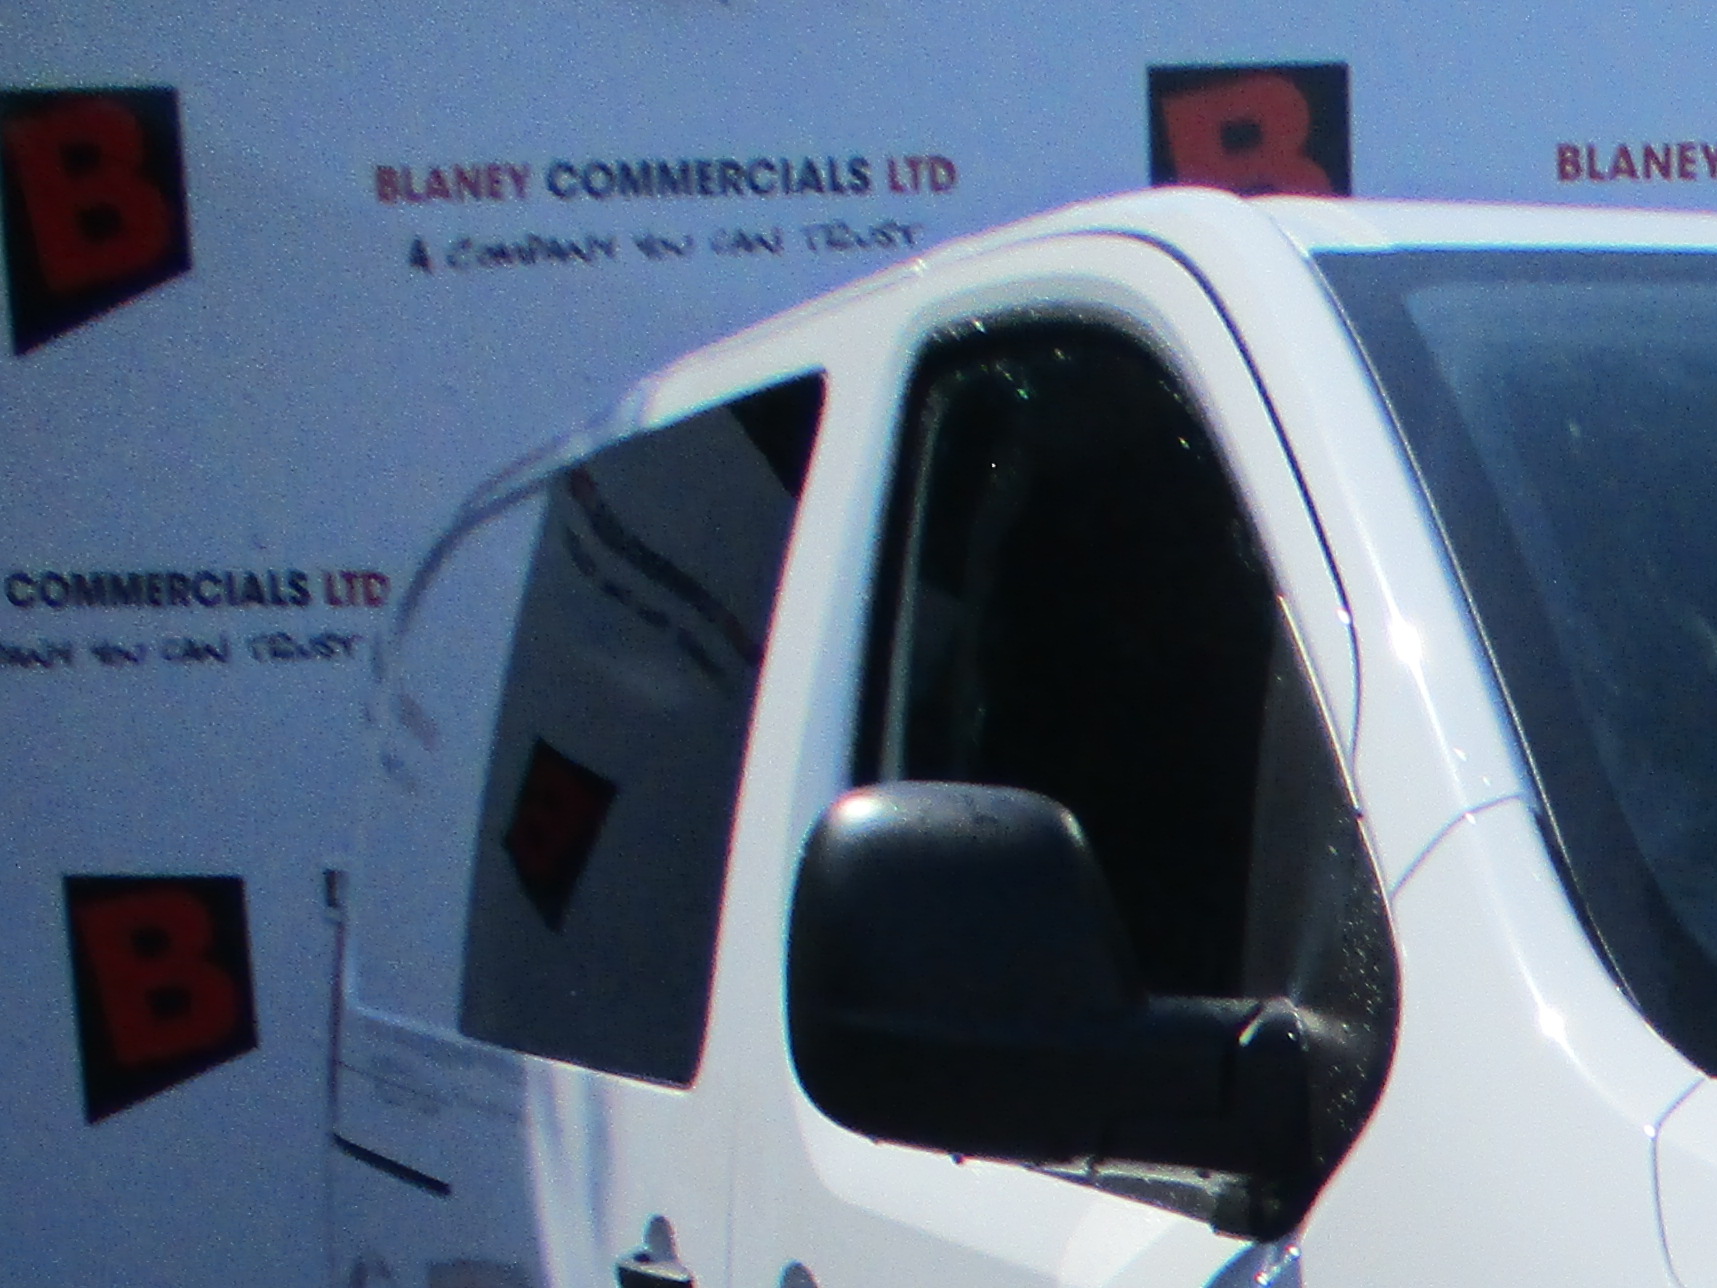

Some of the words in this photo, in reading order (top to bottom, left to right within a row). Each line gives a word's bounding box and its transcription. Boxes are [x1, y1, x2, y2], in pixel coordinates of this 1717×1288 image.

[375, 162, 530, 203] BLANEY
[546, 156, 871, 199] COMMERCIALS
[886, 155, 956, 196] LTD
[5, 569, 312, 610] COMMERCIALS
[323, 569, 392, 608] LTD
[77, 889, 238, 1067] B
